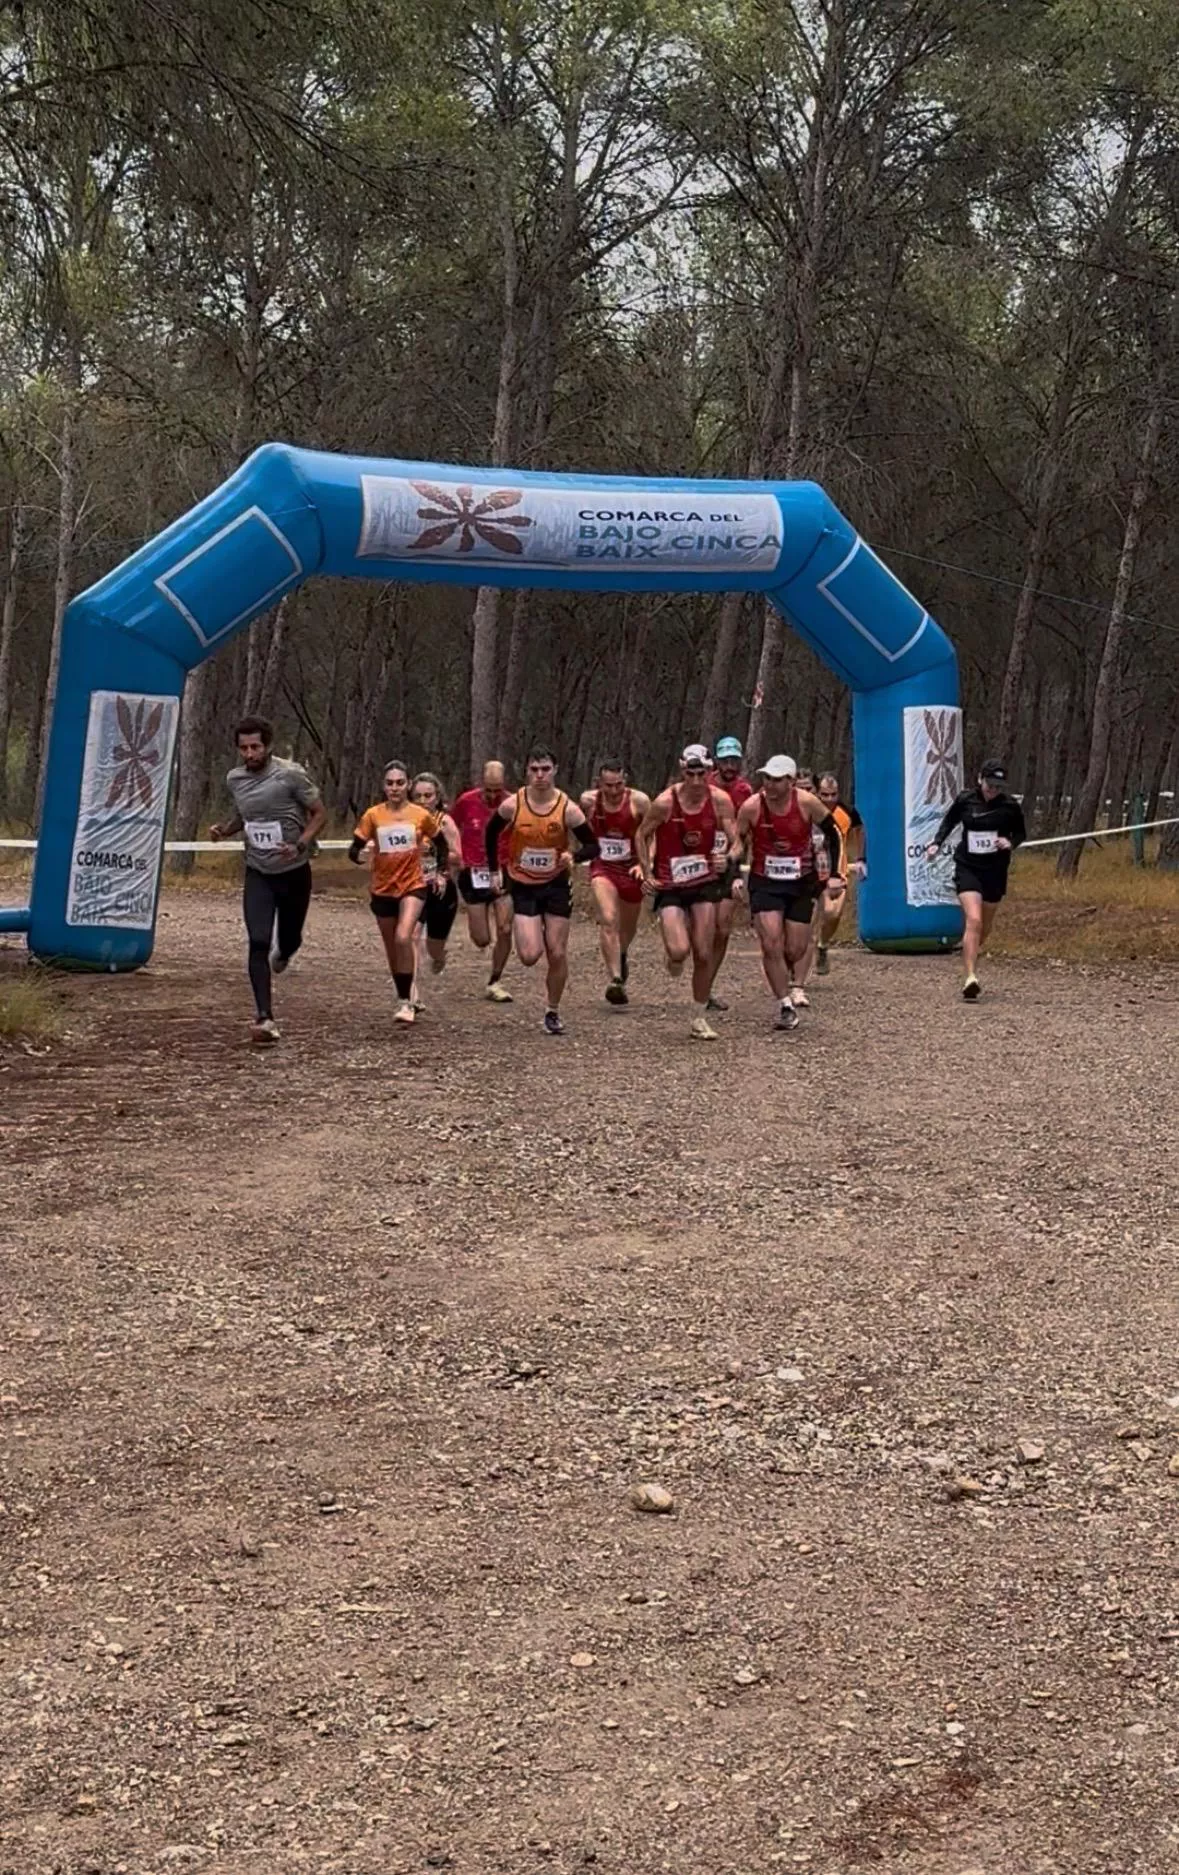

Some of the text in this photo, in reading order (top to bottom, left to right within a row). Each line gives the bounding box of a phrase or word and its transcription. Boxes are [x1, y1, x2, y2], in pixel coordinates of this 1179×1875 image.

[578, 510, 743, 522] COMARCA DEL
[579, 525, 781, 550] BAJO CINCA
[576, 545, 659, 558] BAIX
[254, 832, 271, 842] 171
[388, 836, 407, 846] 136
[77, 851, 133, 869] COMARCA
[530, 857, 548, 866] 182
